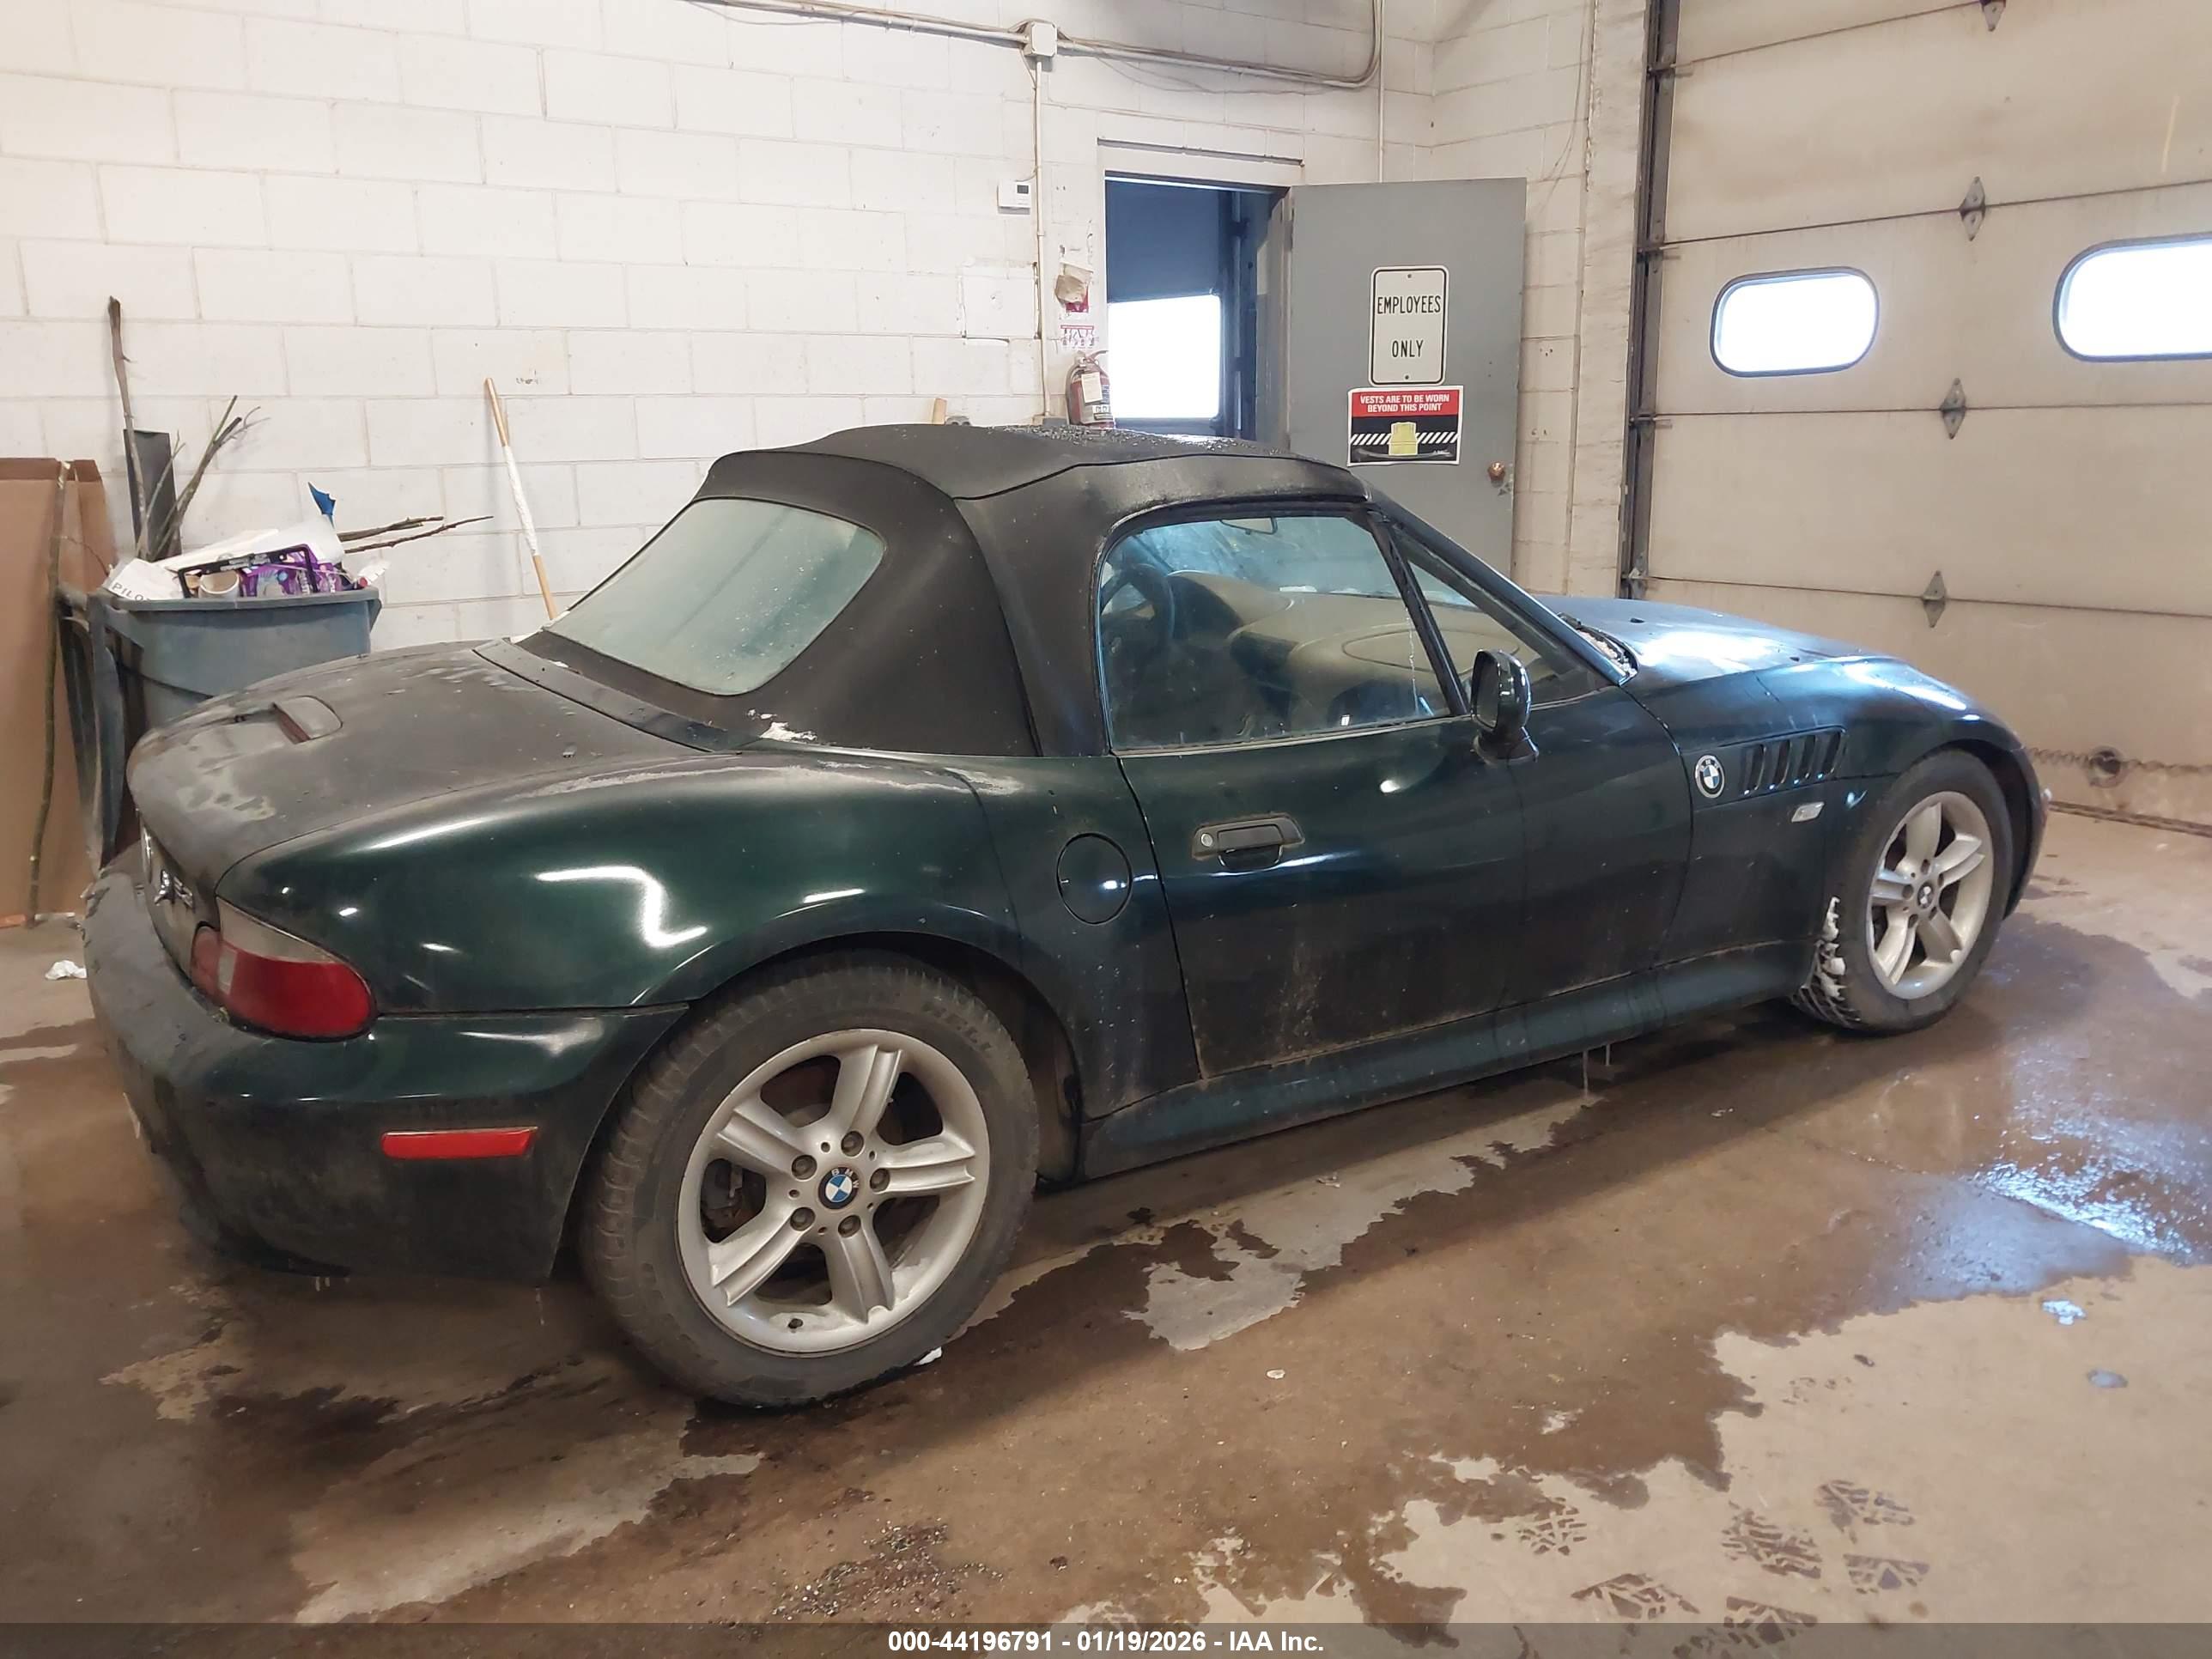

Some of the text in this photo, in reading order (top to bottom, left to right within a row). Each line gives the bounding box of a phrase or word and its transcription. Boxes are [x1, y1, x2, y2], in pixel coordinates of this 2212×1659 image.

[1377, 295, 1442, 314] EMPLOYEES
[1392, 339, 1424, 358] ONLY
[1359, 395, 1384, 404] VESTS
[1385, 395, 1401, 404] ARE
[1413, 394, 1424, 403] BE
[1425, 393, 1450, 403] WORN
[1367, 404, 1398, 412] BEYOND
[1419, 403, 1443, 411] POINT
